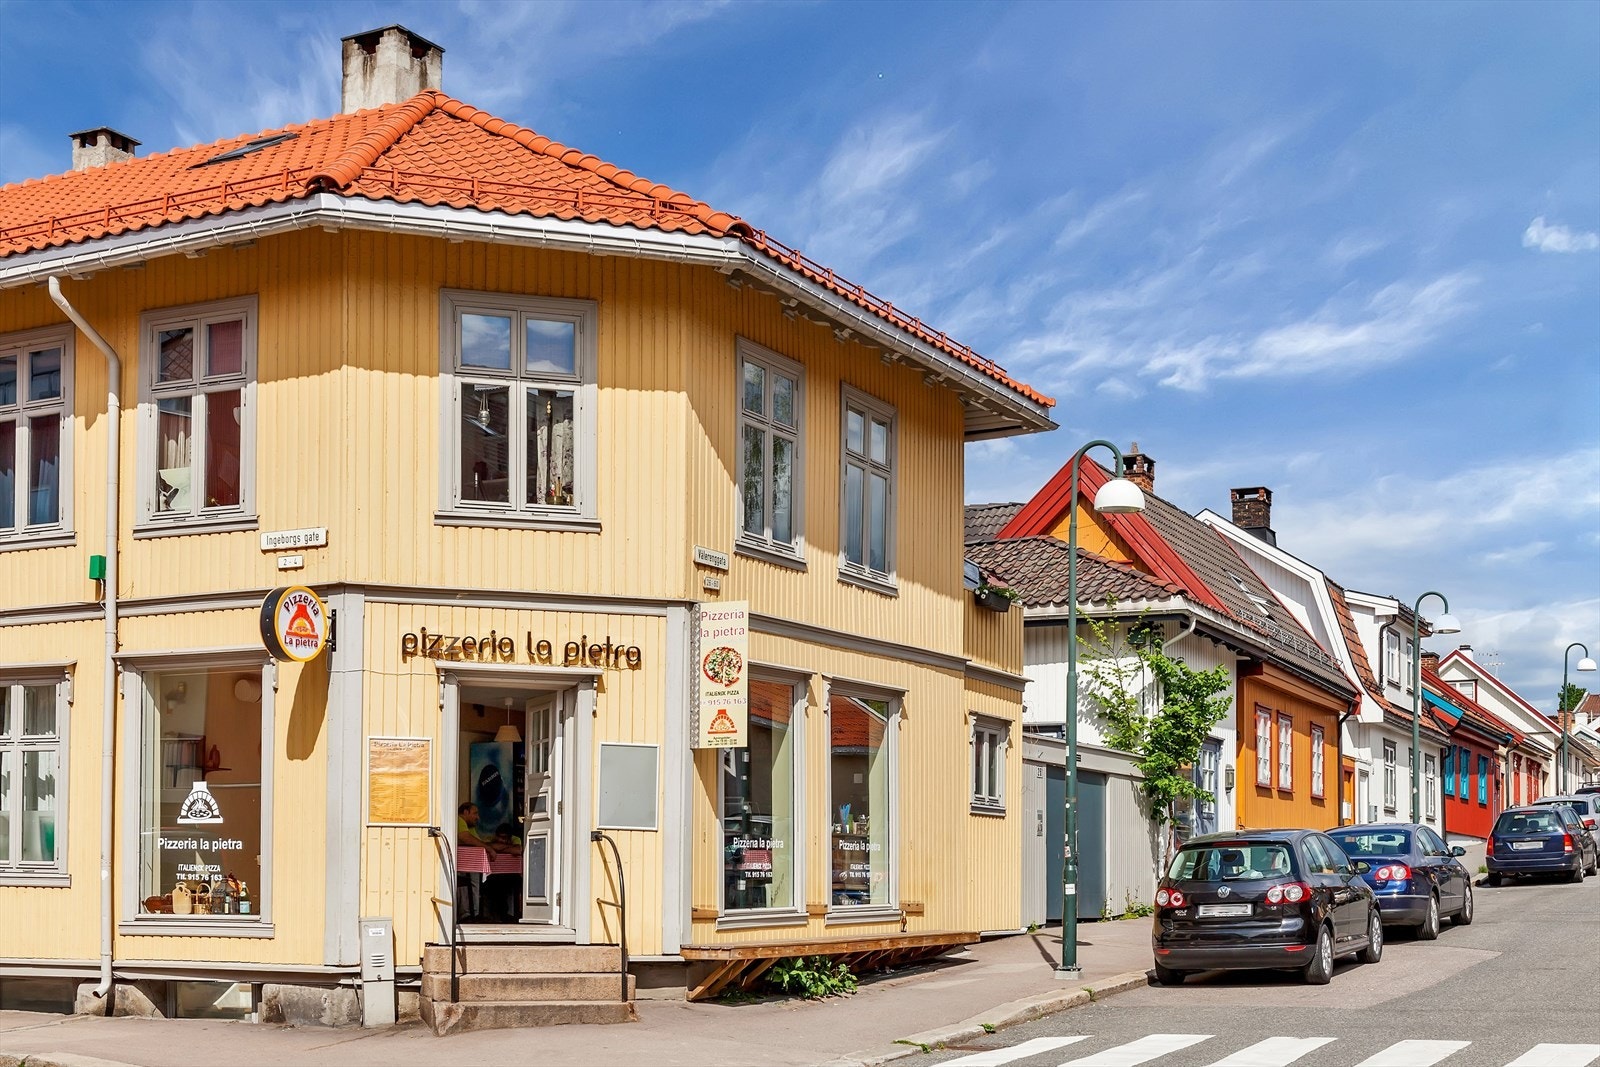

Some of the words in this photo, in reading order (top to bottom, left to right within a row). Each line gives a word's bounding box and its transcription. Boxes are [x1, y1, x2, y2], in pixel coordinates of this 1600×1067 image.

[266, 534, 301, 547] Ingeborgs
[304, 532, 320, 545] gate
[283, 594, 320, 617] Pizzeria
[700, 609, 745, 621] Pizzeria
[700, 628, 709, 638] la
[713, 626, 745, 640] pietra
[284, 634, 293, 646] La
[295, 636, 319, 649] pietra
[402, 626, 515, 658] pizzeria
[526, 630, 552, 657] la
[564, 634, 642, 668] pietra
[157, 838, 197, 850] Pizzeria
[200, 838, 209, 850] la
[212, 838, 243, 853] pietra
[733, 837, 758, 848] Pizzeria
[759, 837, 765, 848] la
[766, 838, 784, 850] pietra
[839, 840, 860, 851] Pizzeria
[860, 840, 865, 850] la
[178, 864, 204, 872] ITALIENSK
[205, 864, 221, 872] PIZZA
[187, 873, 200, 881] 915
